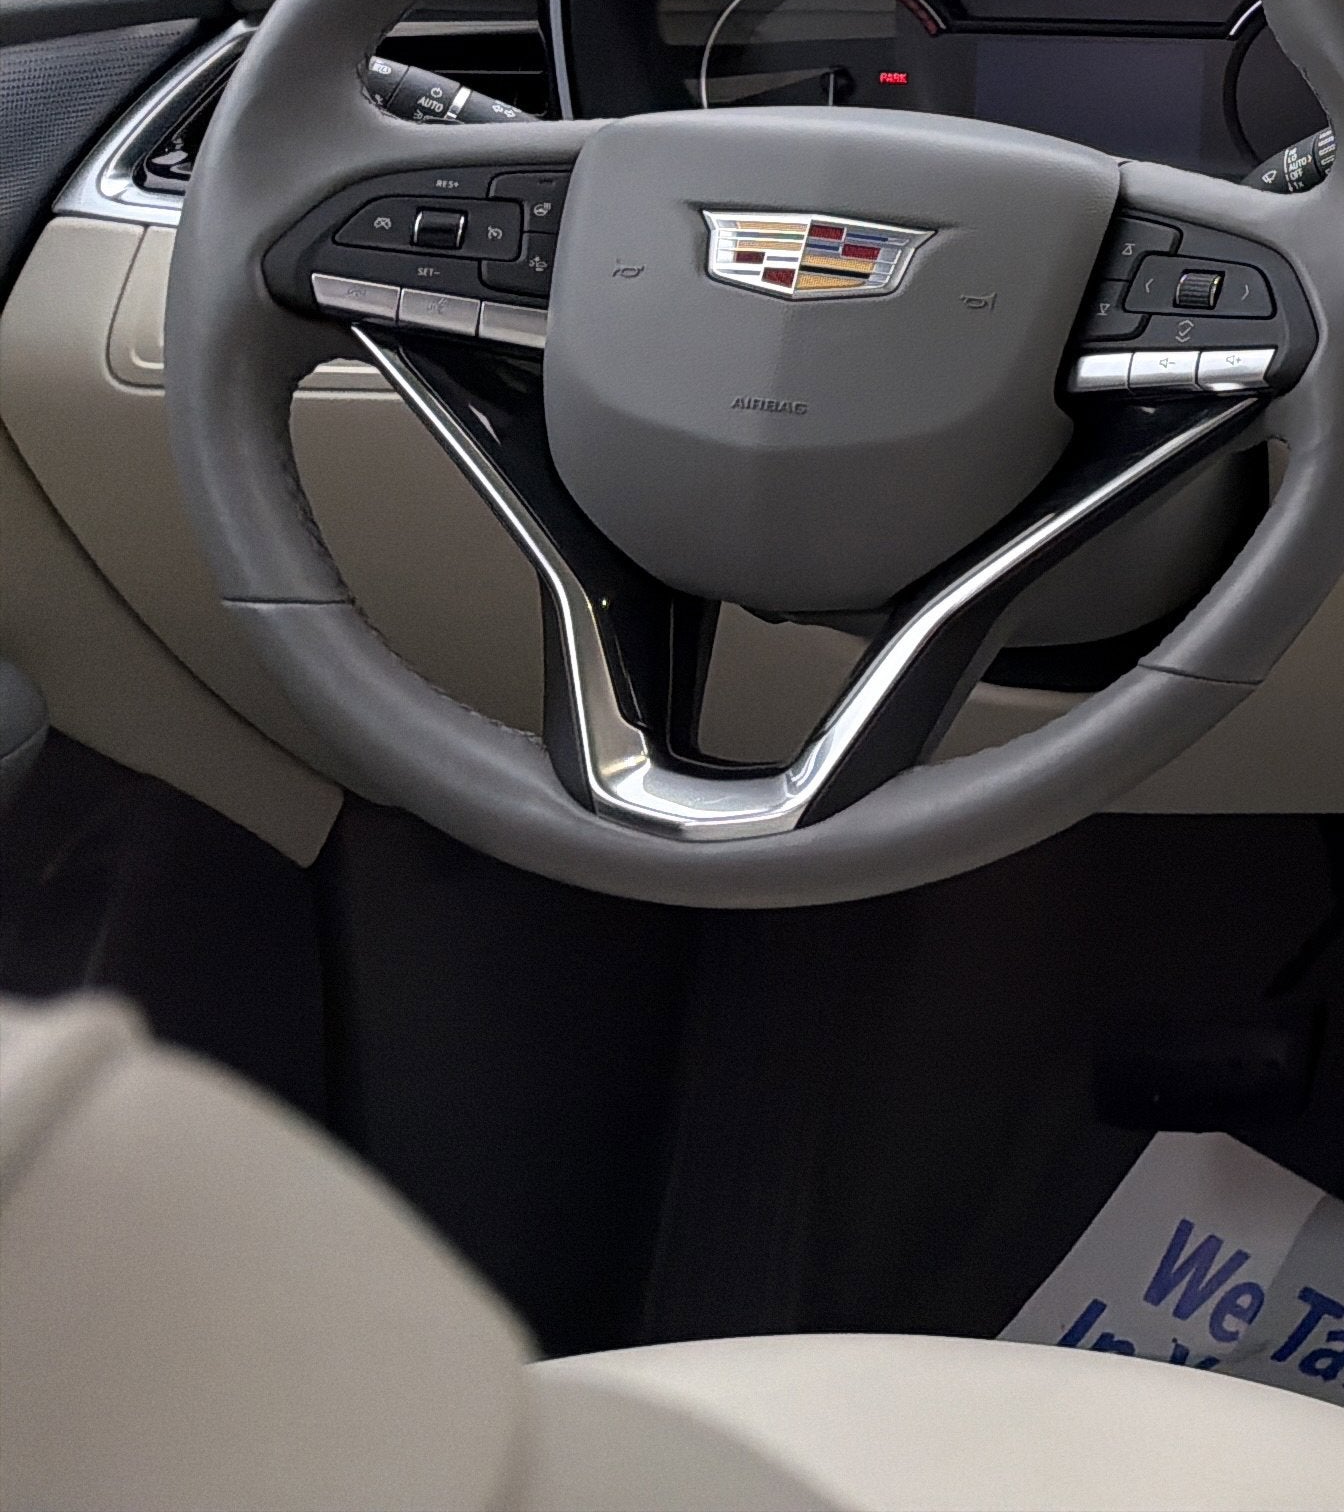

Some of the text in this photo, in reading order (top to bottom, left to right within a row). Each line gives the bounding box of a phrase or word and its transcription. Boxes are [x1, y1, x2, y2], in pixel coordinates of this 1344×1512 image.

[880, 72, 908, 84] PARK
[417, 96, 444, 113] AUTO
[1289, 157, 1307, 172] AUTO
[1290, 168, 1303, 180] OFF
[731, 397, 808, 415] AIRBAG
[1142, 1218, 1266, 1345] We
